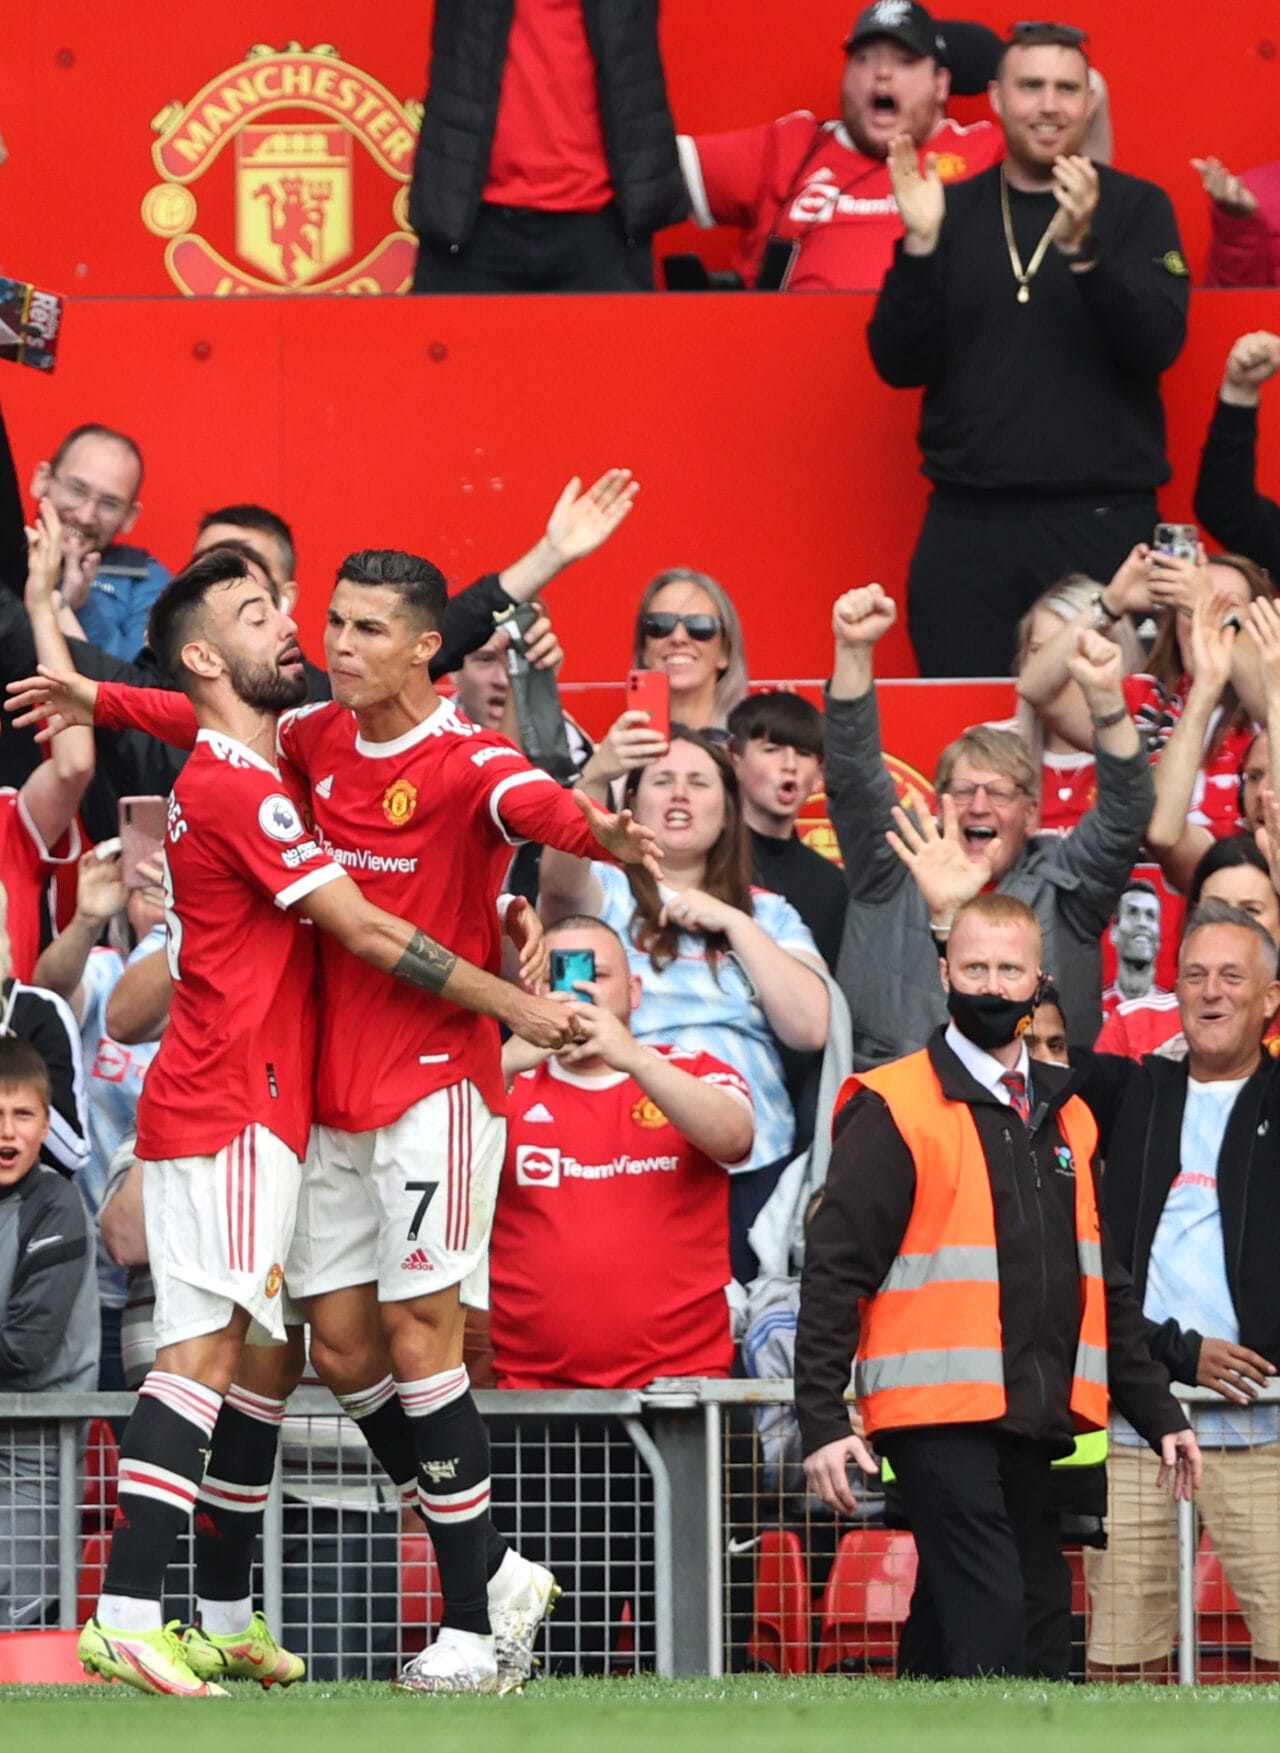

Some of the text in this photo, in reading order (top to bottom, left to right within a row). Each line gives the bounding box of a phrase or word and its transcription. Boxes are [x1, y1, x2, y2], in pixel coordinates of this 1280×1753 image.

[173, 64, 416, 163] MANCHESTER
[322, 840, 418, 873] TeamViewer
[560, 1155, 680, 1180] TeamViewer
[405, 1181, 440, 1241] 7
[400, 1262, 434, 1271] adidas
